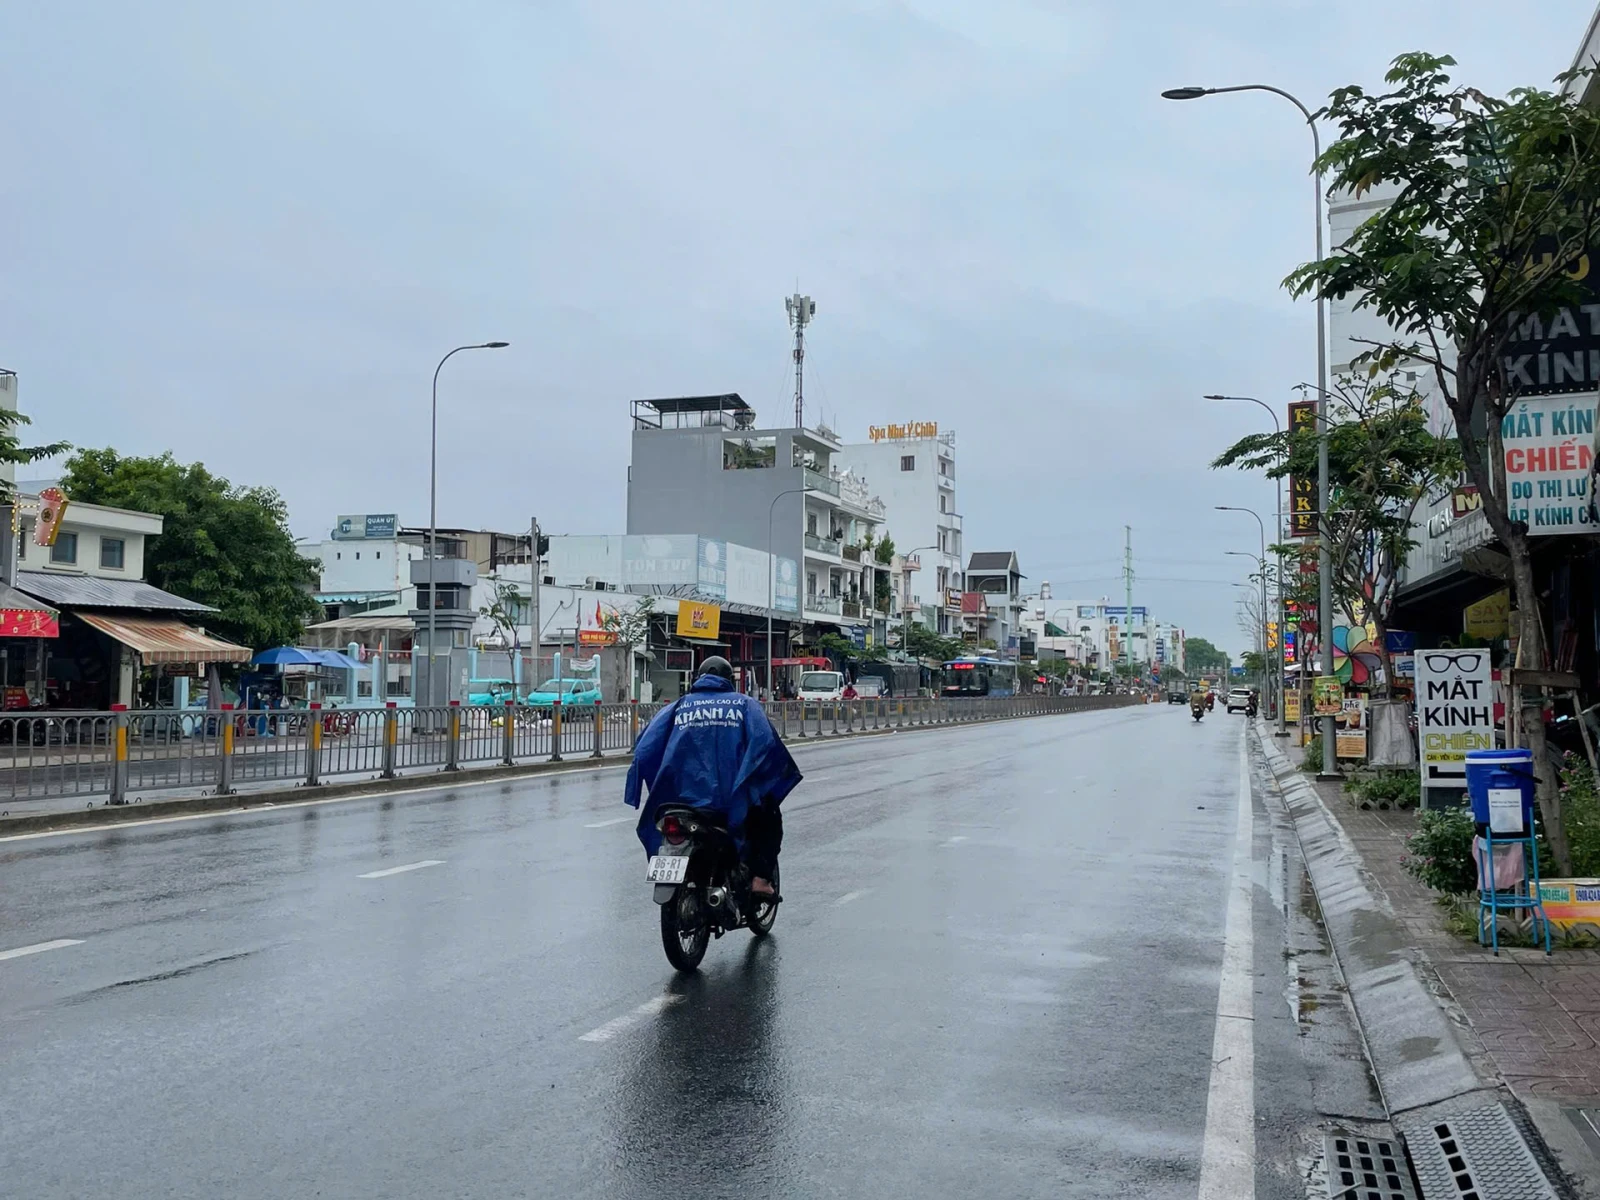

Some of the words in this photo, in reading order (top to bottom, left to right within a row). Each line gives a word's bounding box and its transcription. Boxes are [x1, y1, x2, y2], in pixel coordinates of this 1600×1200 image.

[1552, 404, 1596, 436] KÍN
[869, 425, 885, 443] Spa
[915, 421, 937, 437] Chibi
[1535, 504, 1573, 526] KÍNH
[1427, 674, 1483, 701] MẮT
[674, 707, 724, 725] KHÁNH
[725, 708, 744, 721] AN
[1424, 703, 1490, 727] KÍNH
[1425, 729, 1490, 750] CHIẾN
